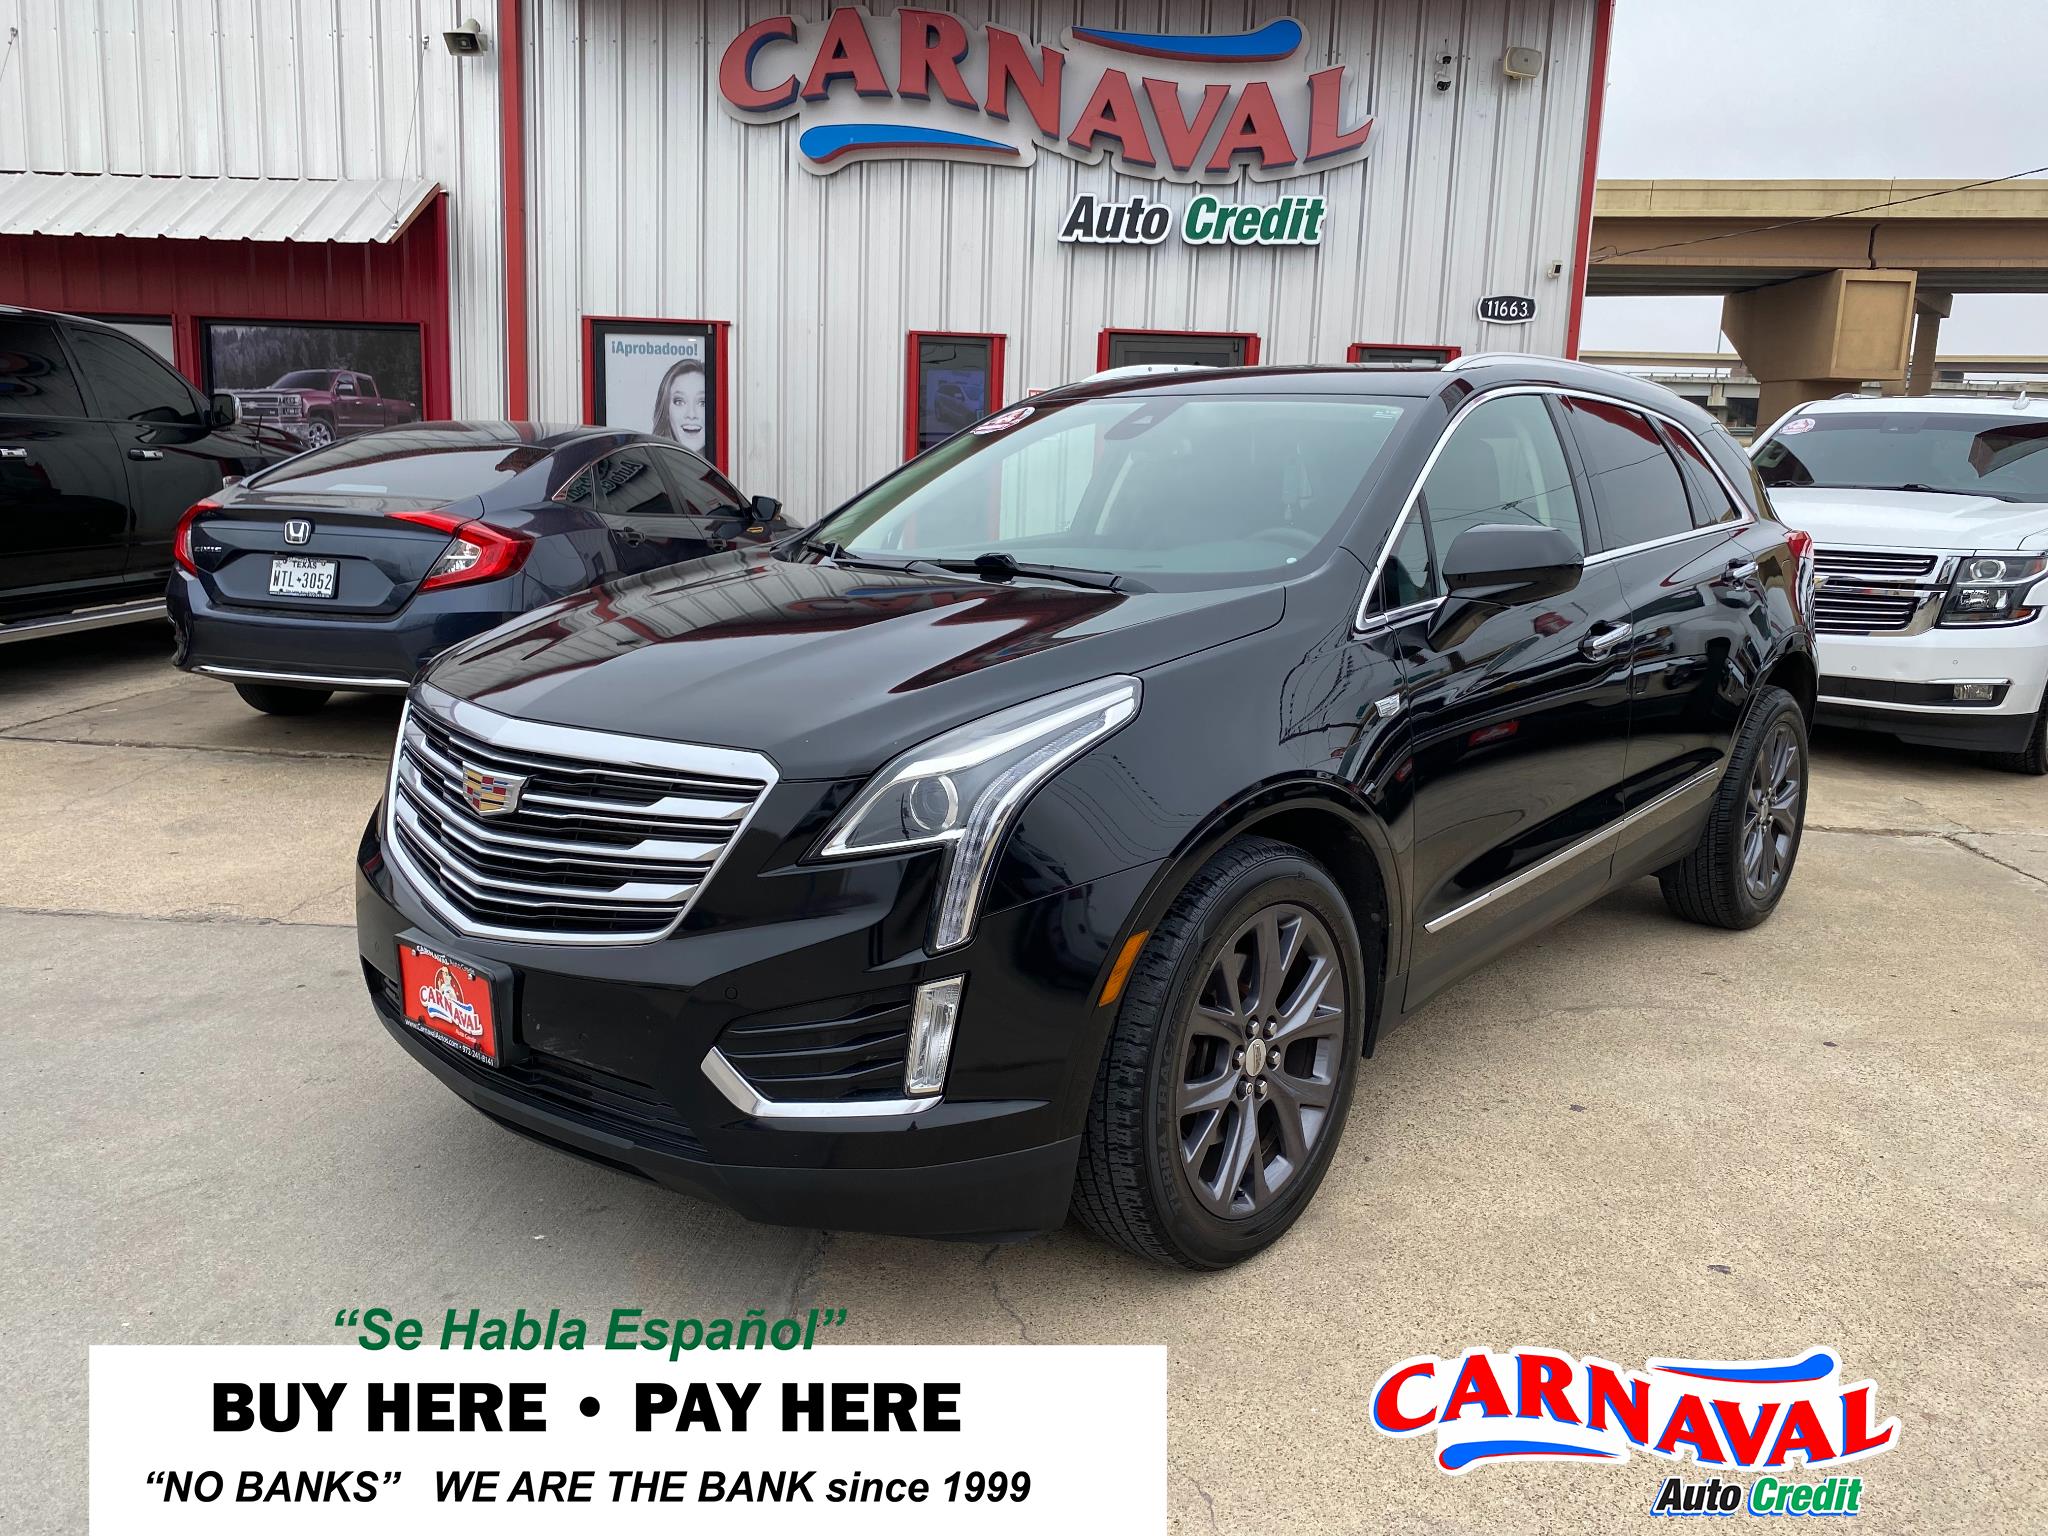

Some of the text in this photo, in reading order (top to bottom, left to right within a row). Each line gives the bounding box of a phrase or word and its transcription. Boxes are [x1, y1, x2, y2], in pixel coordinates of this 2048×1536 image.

[718, 6, 1374, 173] CARNAVAL
[1062, 195, 1325, 244] Auto Credit
[1487, 300, 1528, 318] 11663
[611, 340, 698, 357] ¡Aprobadooo!
[292, 560, 318, 569] TEXAS
[420, 986, 483, 1032] CARNAVAL
